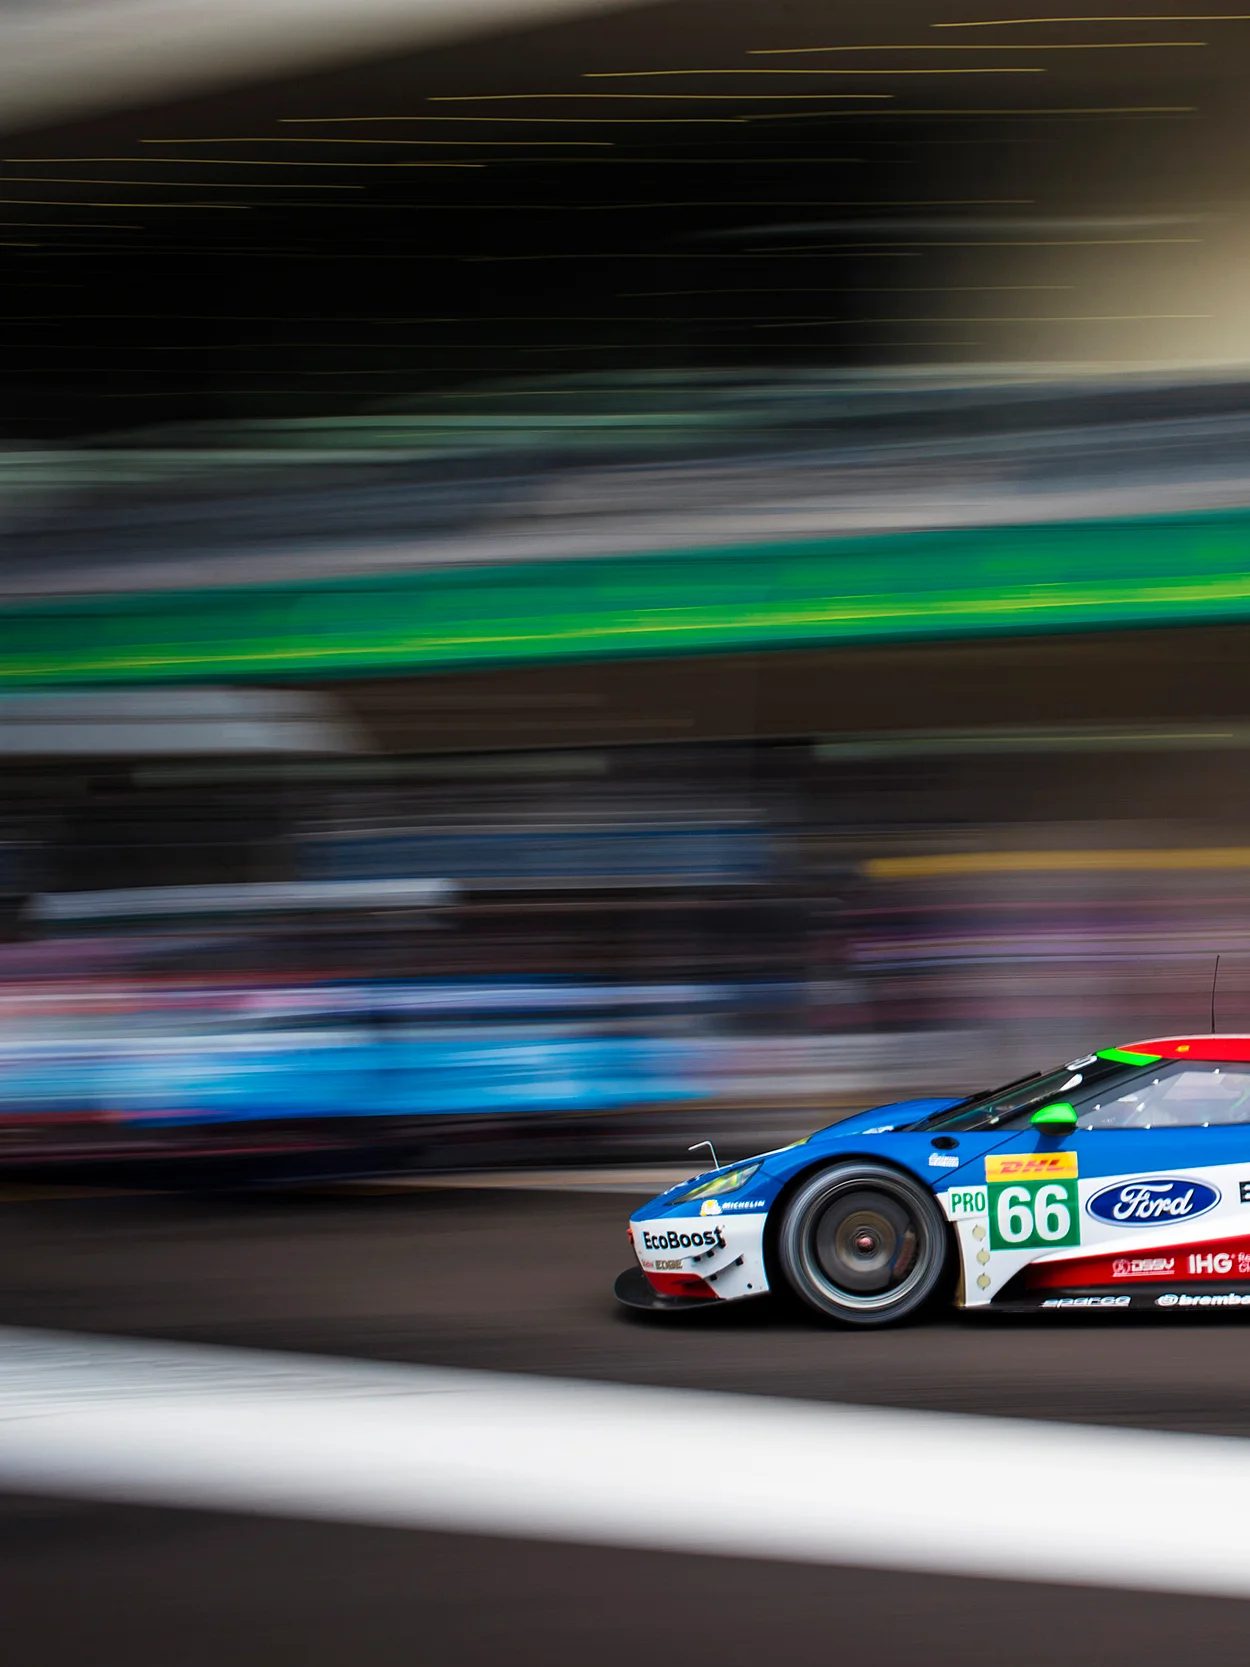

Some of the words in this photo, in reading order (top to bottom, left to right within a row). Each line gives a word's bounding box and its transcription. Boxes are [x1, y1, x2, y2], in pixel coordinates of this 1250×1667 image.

[999, 1158, 1065, 1174] DHL
[721, 1199, 766, 1211] MICHELIN
[951, 1191, 986, 1213] PRO
[1113, 1183, 1195, 1220] Ford
[997, 1184, 1071, 1243] 66
[643, 1225, 723, 1250] EcoBoost
[1188, 1252, 1234, 1275] IHG
